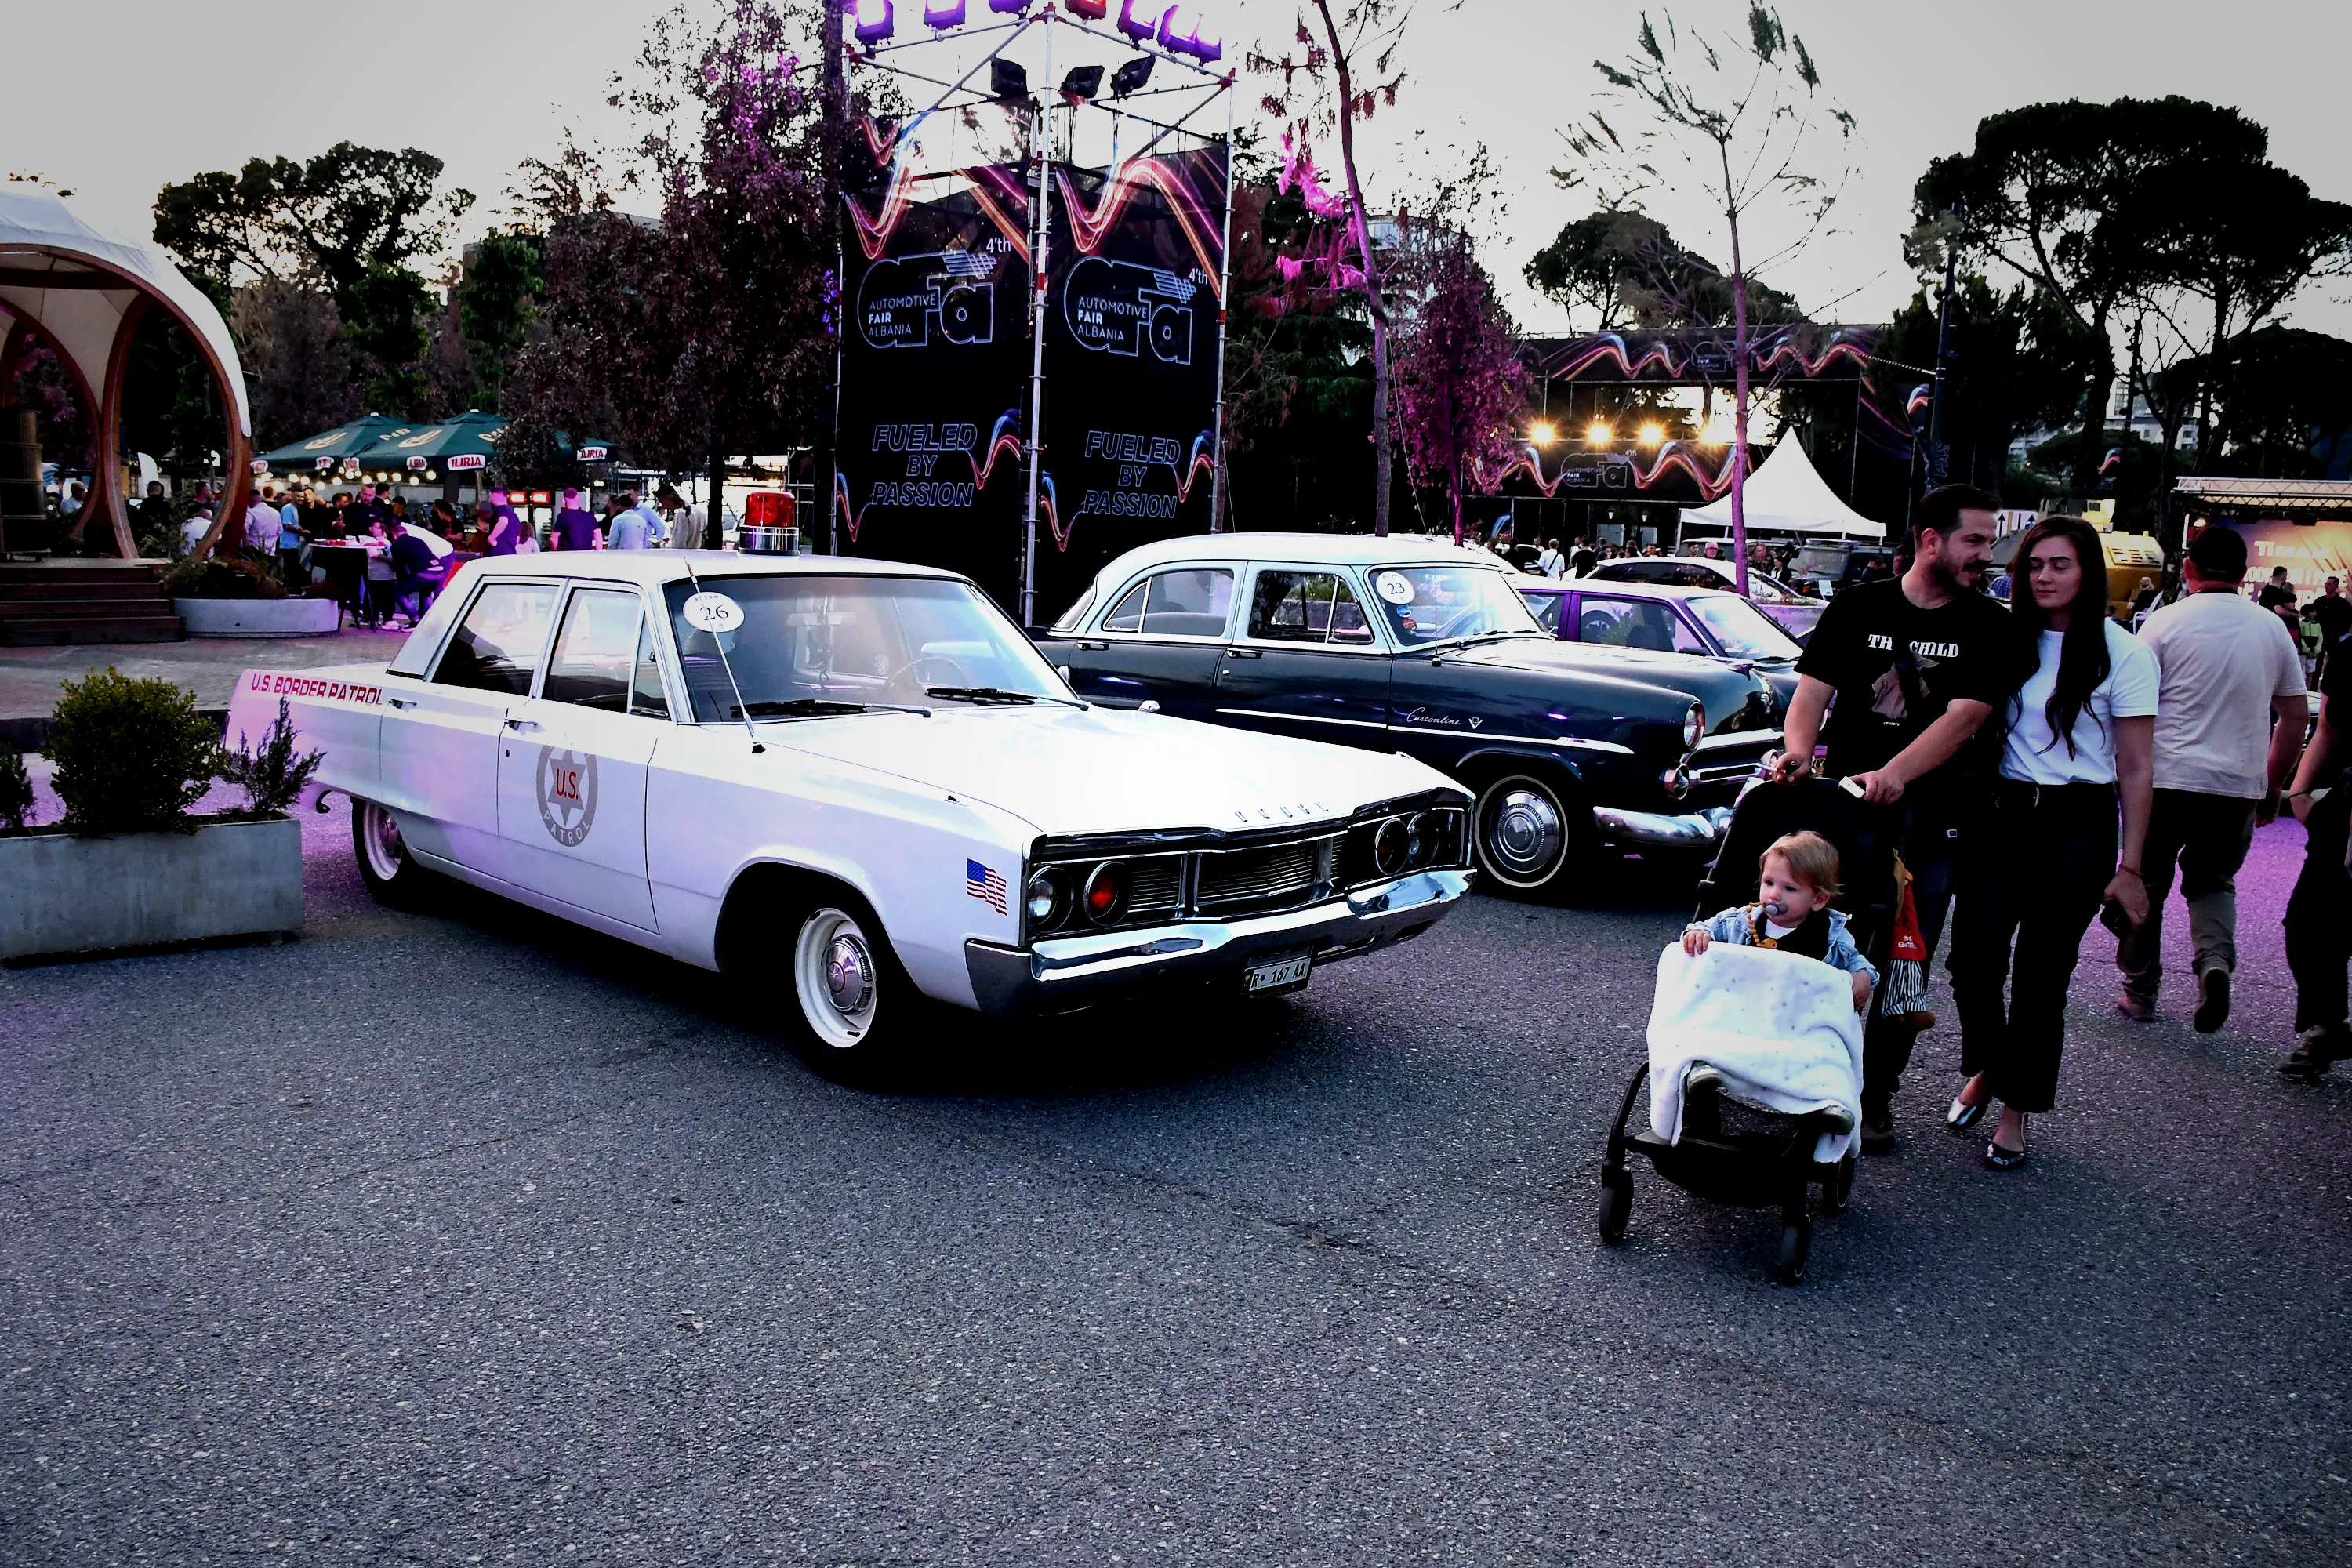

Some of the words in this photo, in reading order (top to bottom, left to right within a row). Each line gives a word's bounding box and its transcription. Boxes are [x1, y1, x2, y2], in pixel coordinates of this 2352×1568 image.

[869, 293, 936, 311] AUTOMOTIVE
[1078, 296, 1148, 319] AUTOMOTIVE
[868, 311, 891, 325] FAIR
[1077, 308, 1103, 325] FAIR
[868, 323, 912, 338] ALBANIA
[1077, 324, 1124, 343] ALBANIA
[872, 423, 978, 452] FUELED
[1084, 430, 1181, 465] FUELED
[452, 456, 482, 468] ILIRIA
[906, 455, 938, 477] BY
[1118, 464, 1148, 488] BY
[872, 482, 975, 507] PASSION
[1083, 489, 1178, 519] PASSION
[1386, 582, 1406, 595] 23
[699, 604, 729, 621] 26
[1867, 633, 1893, 651] TH
[1908, 641, 1959, 658] CHILD
[251, 673, 271, 692] U.S.
[273, 676, 327, 697] BORDER
[328, 683, 383, 706] PATROL
[556, 768, 579, 800] U.S.
[543, 811, 590, 844] PATROL
[1270, 966, 1290, 984] 167
[1292, 962, 1306, 978] AA
